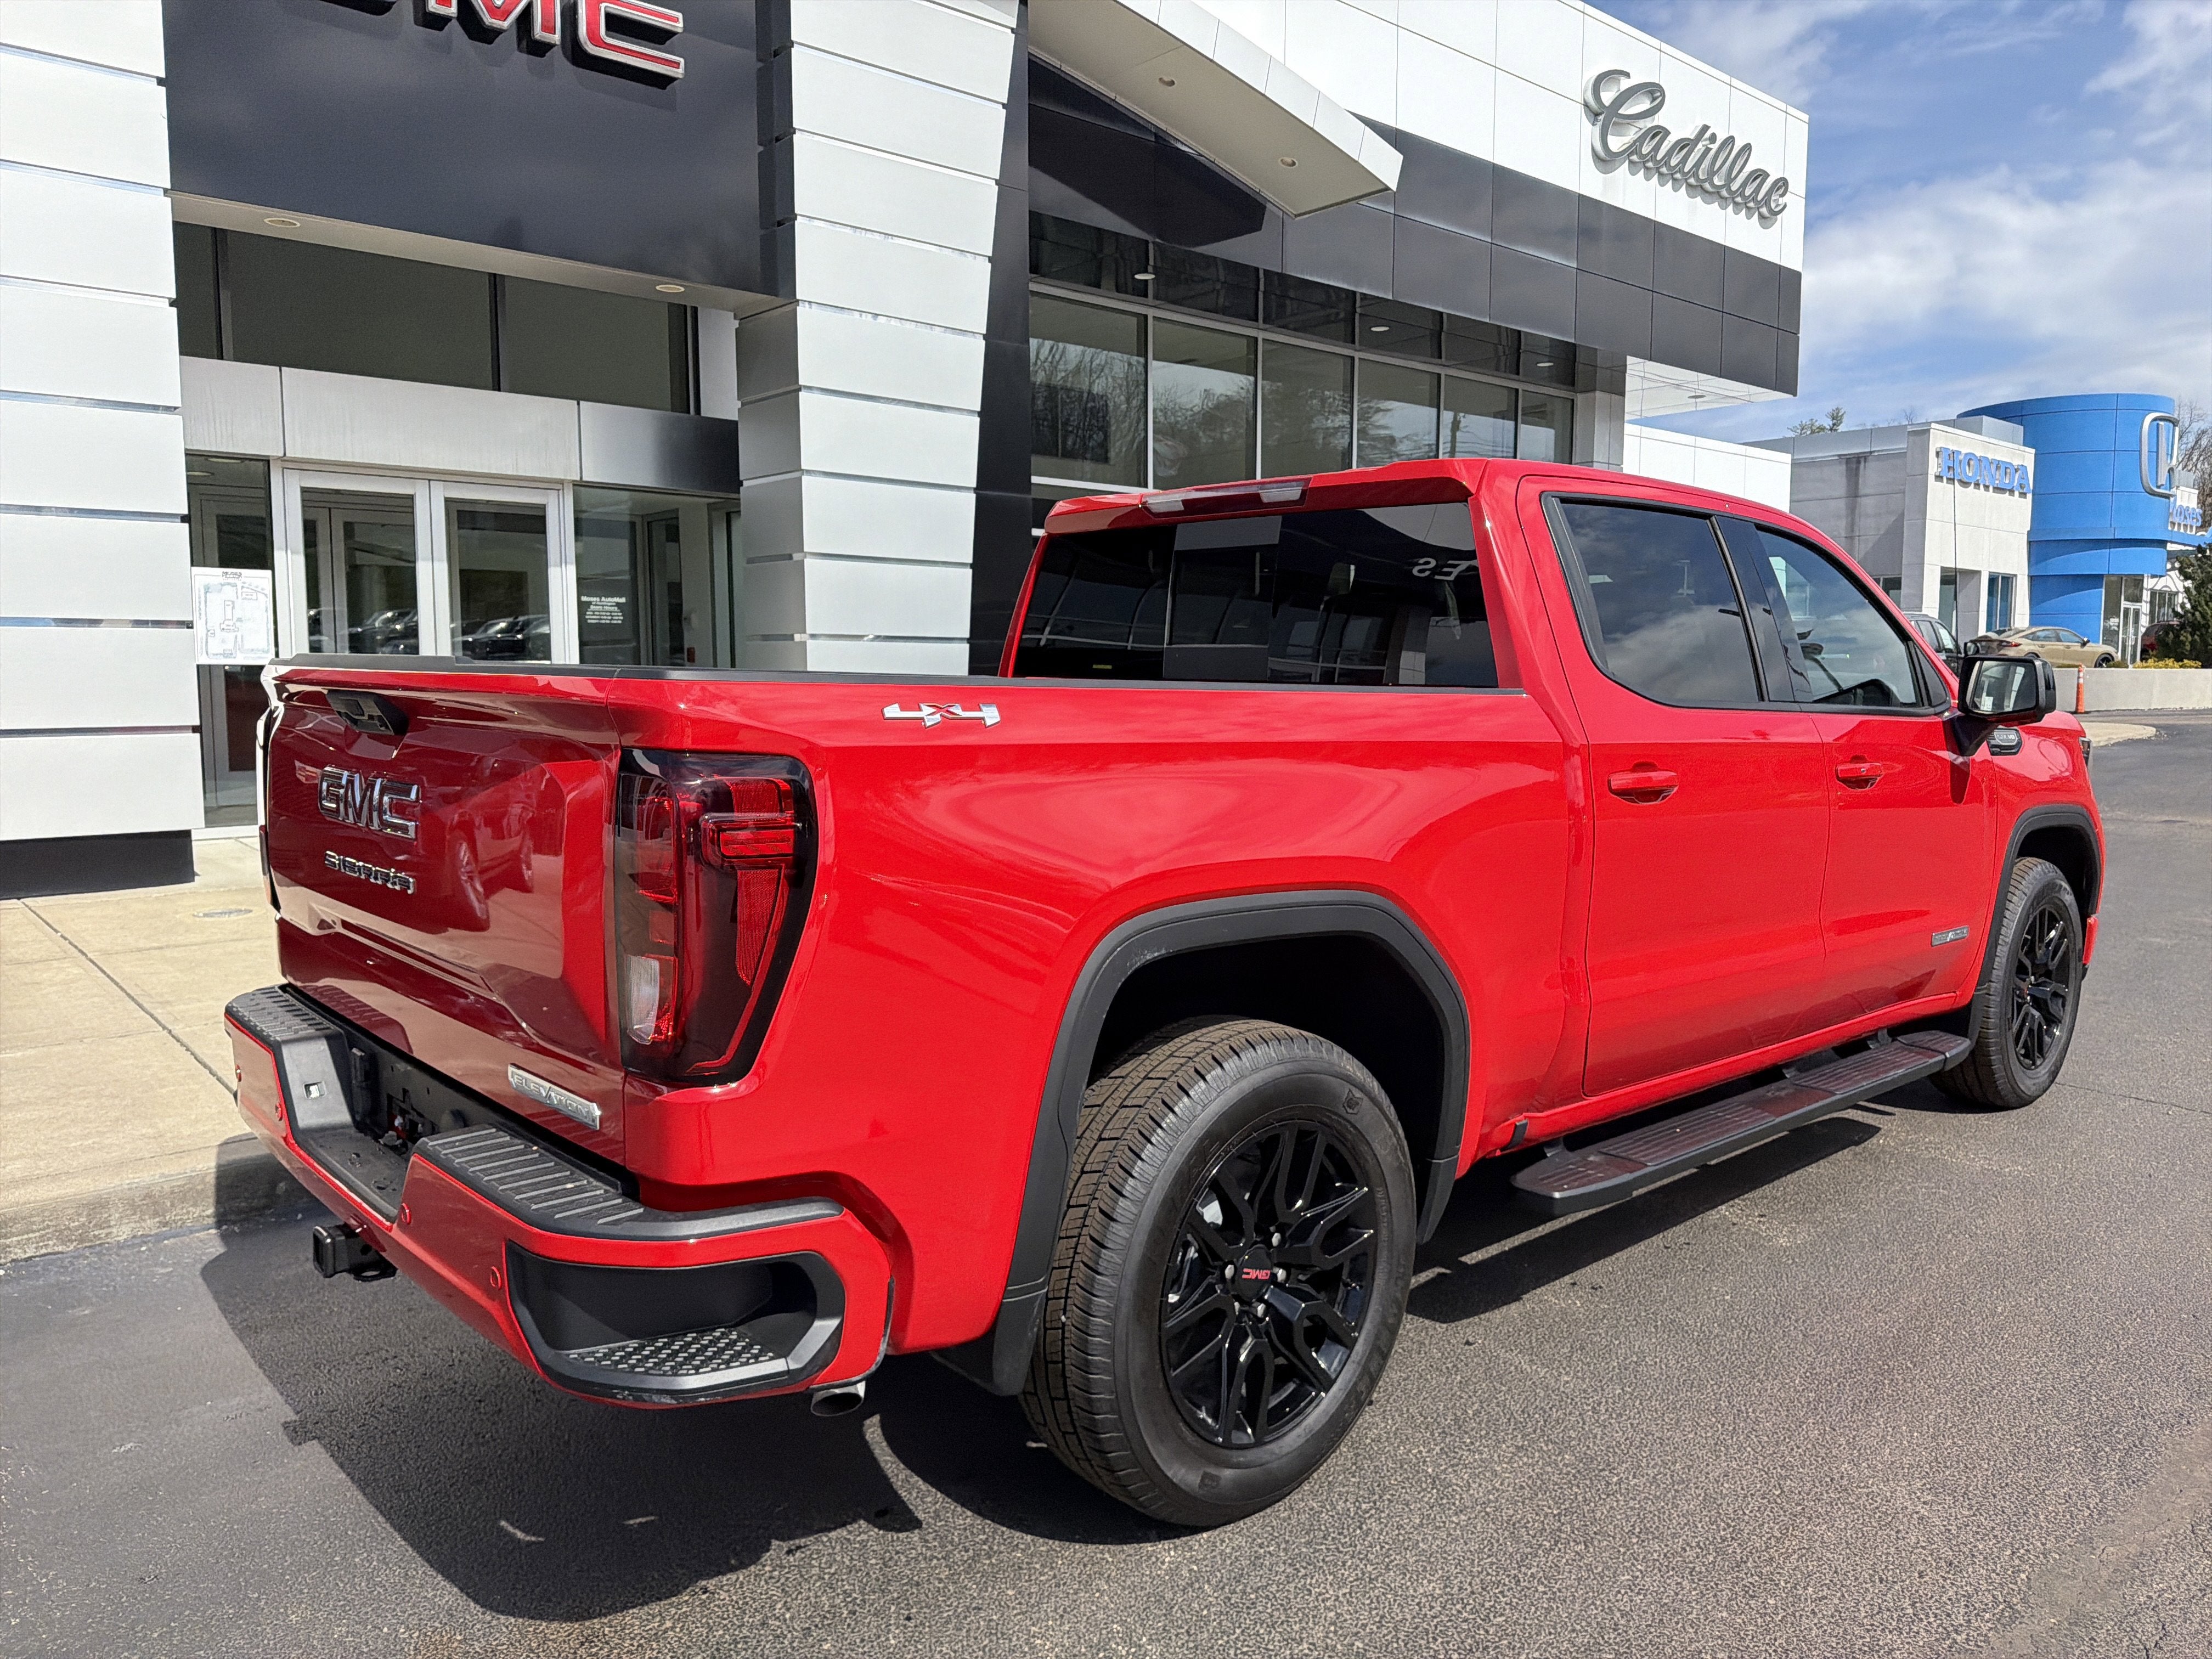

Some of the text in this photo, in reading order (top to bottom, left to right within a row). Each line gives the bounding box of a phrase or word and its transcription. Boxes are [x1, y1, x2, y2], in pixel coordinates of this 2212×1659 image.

[426, 0, 685, 78] MC
[1585, 69, 1789, 216] Cadillac
[1937, 447, 2032, 494] HONDA
[318, 764, 421, 840] GMC
[325, 850, 415, 895] SIERRA
[1242, 1268, 1271, 1280] GMC
